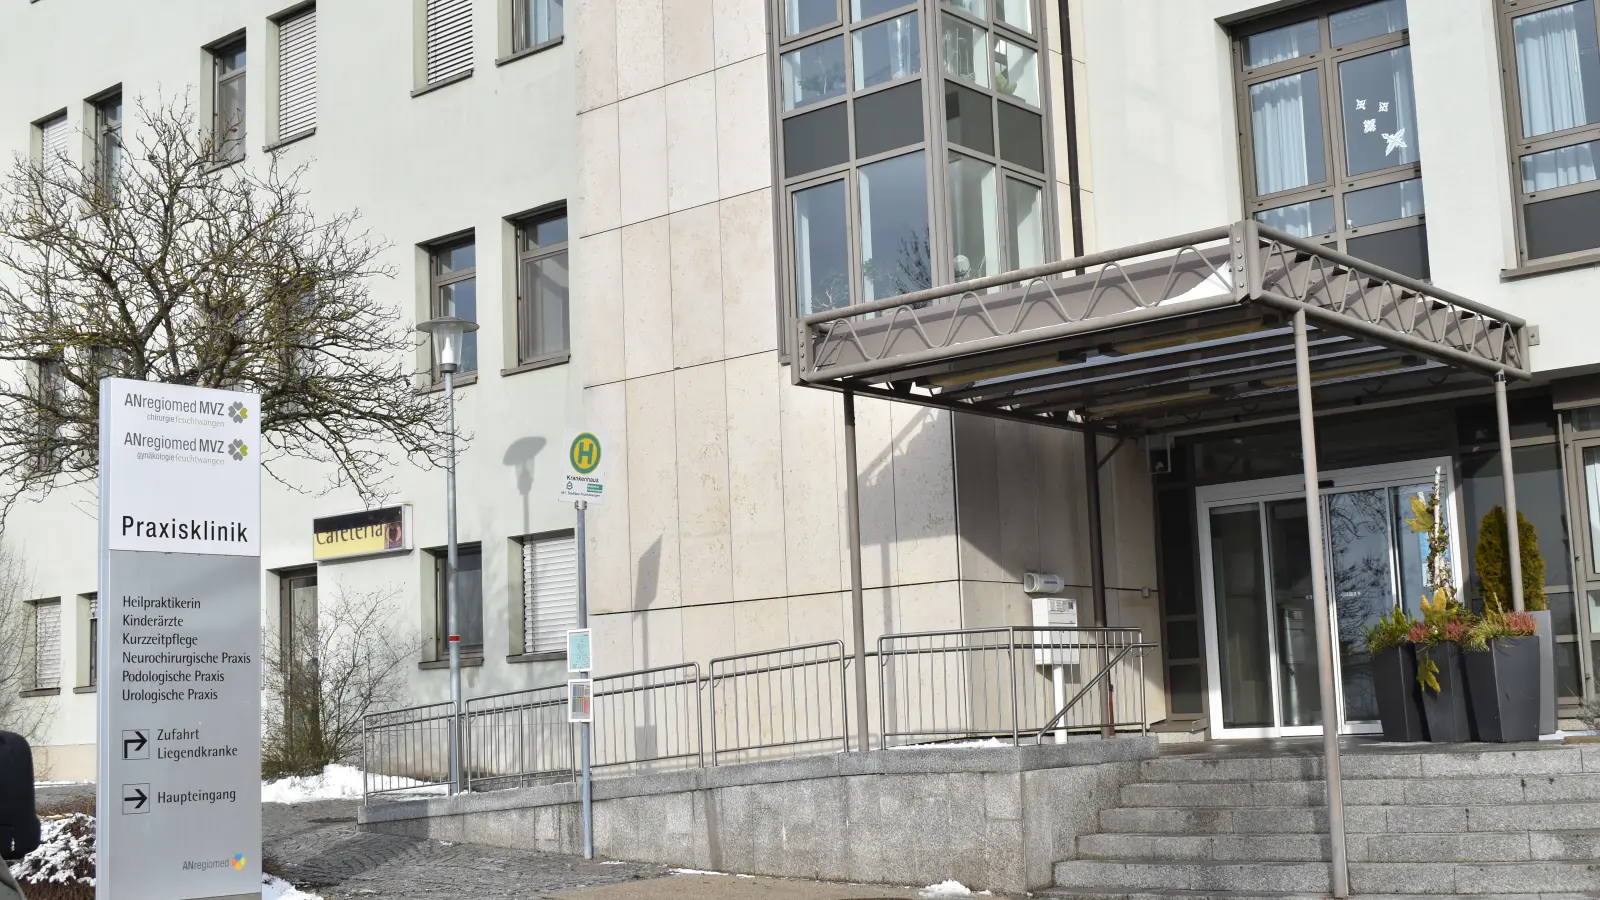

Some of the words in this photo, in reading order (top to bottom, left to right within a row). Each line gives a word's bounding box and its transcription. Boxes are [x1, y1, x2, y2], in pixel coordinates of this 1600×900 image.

[124, 393, 196, 414] ANregiomed
[199, 401, 225, 416] MVZ
[124, 432, 196, 452] ANregiomed
[199, 439, 225, 454] MVZ
[577, 442, 594, 465] H
[566, 475, 599, 483] Krankenhaus
[122, 515, 248, 543] Praxisklinik
[123, 596, 201, 611] Heilpraktikerin
[122, 614, 184, 627] Kinderärzte
[122, 633, 198, 649] Kurzzeitpflege
[122, 652, 219, 667] Neurochirurgische
[221, 652, 251, 664] Praxis
[122, 670, 192, 686] Podologische
[195, 670, 225, 682] Praxis
[122, 688, 185, 704] Urologische
[188, 688, 218, 700] Praxis
[157, 728, 200, 741] Zufahrt
[157, 745, 238, 762] Liegendkranke
[157, 790, 236, 805] Haupteingang
[182, 858, 230, 872] ANregiomed
